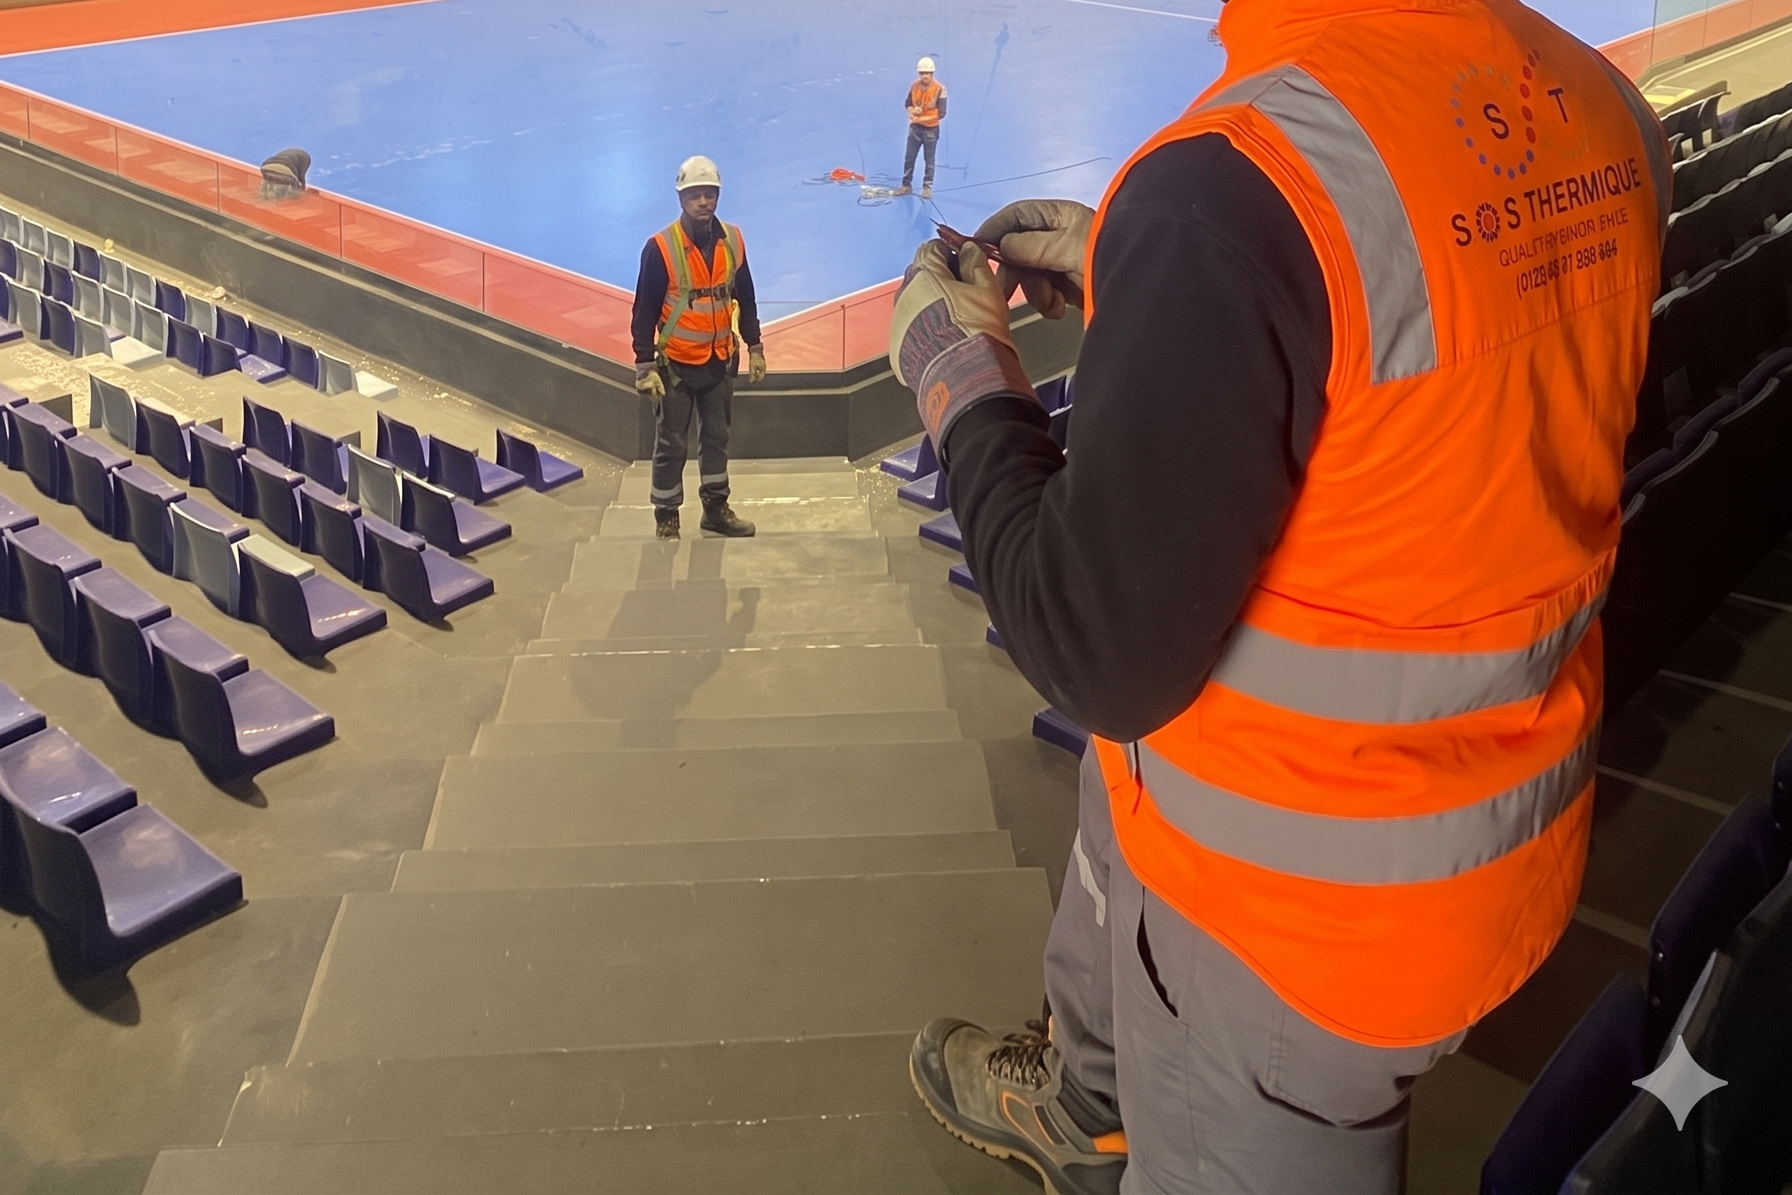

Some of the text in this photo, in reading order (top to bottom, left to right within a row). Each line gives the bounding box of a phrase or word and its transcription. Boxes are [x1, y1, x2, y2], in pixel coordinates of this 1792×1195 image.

[1483, 87, 1569, 140] S T
[1523, 158, 1642, 223] THERMIQUE
